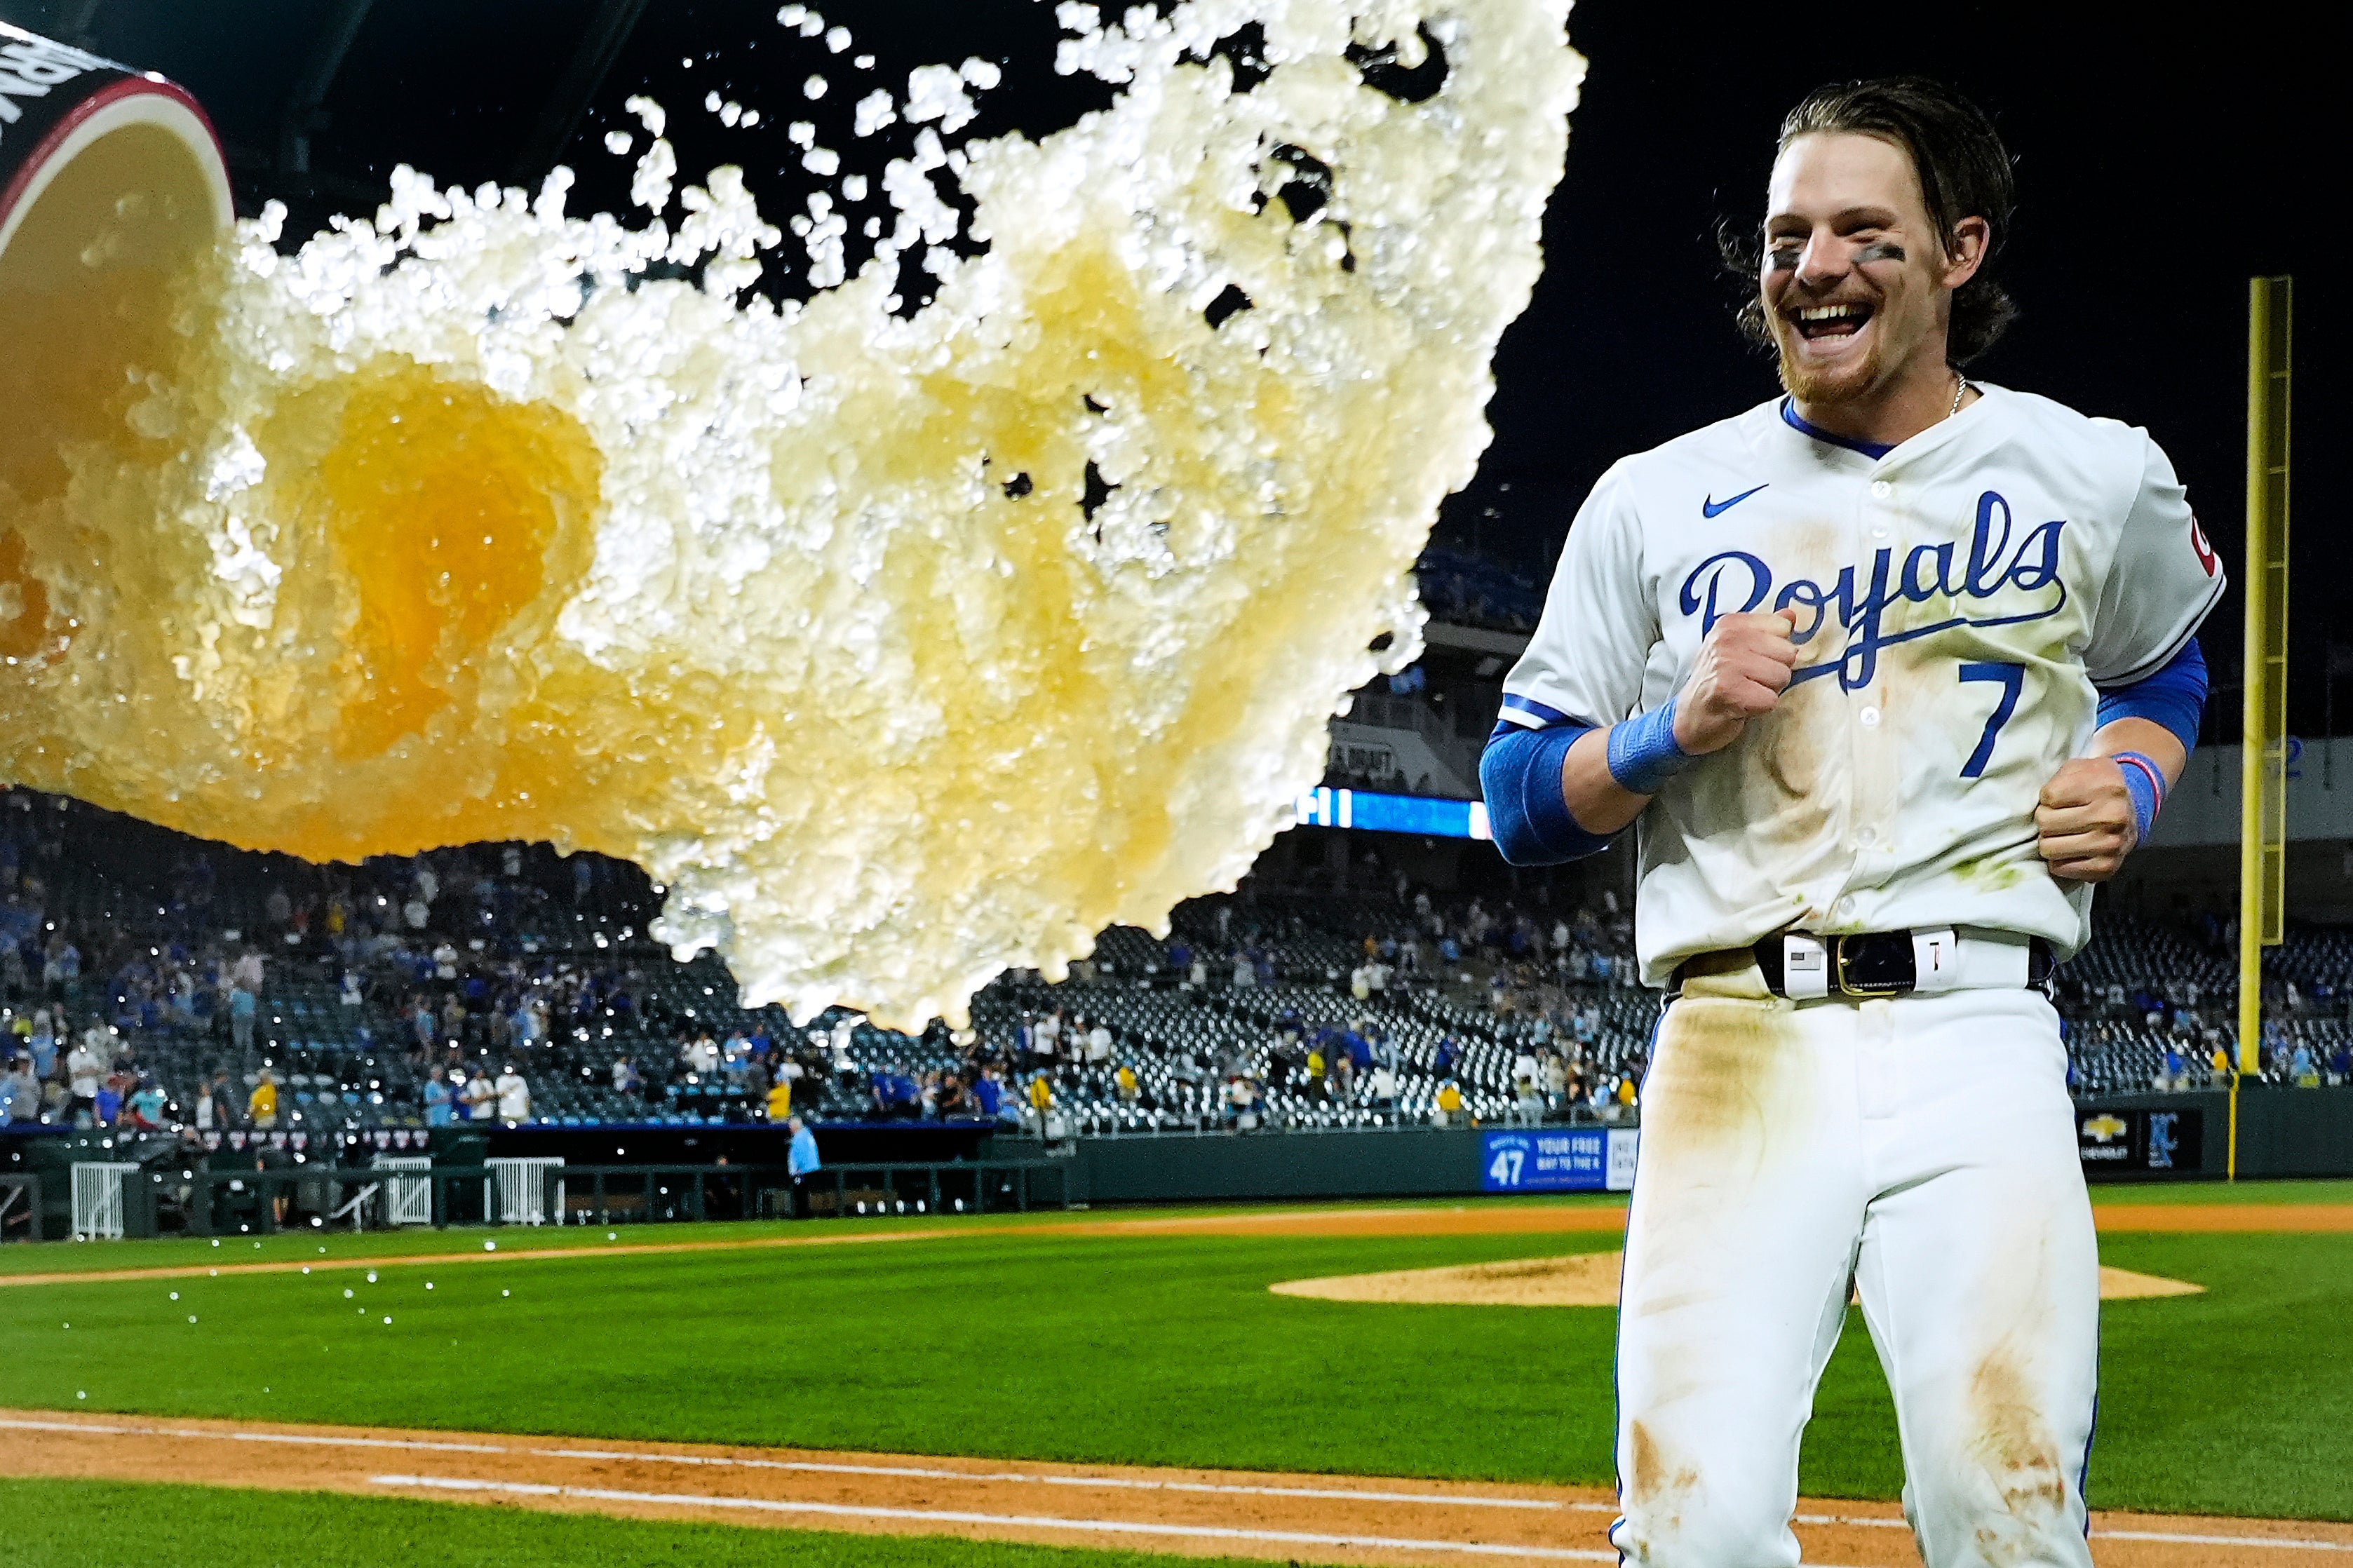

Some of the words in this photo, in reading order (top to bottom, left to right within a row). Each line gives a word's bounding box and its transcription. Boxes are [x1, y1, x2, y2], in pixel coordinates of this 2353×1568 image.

[1680, 490, 2068, 696] Royals
[1958, 662, 2026, 778] 7
[1490, 1150, 1524, 1186] 47
[1537, 1137, 1570, 1155] YOUR
[1572, 1137, 1600, 1155] FREE
